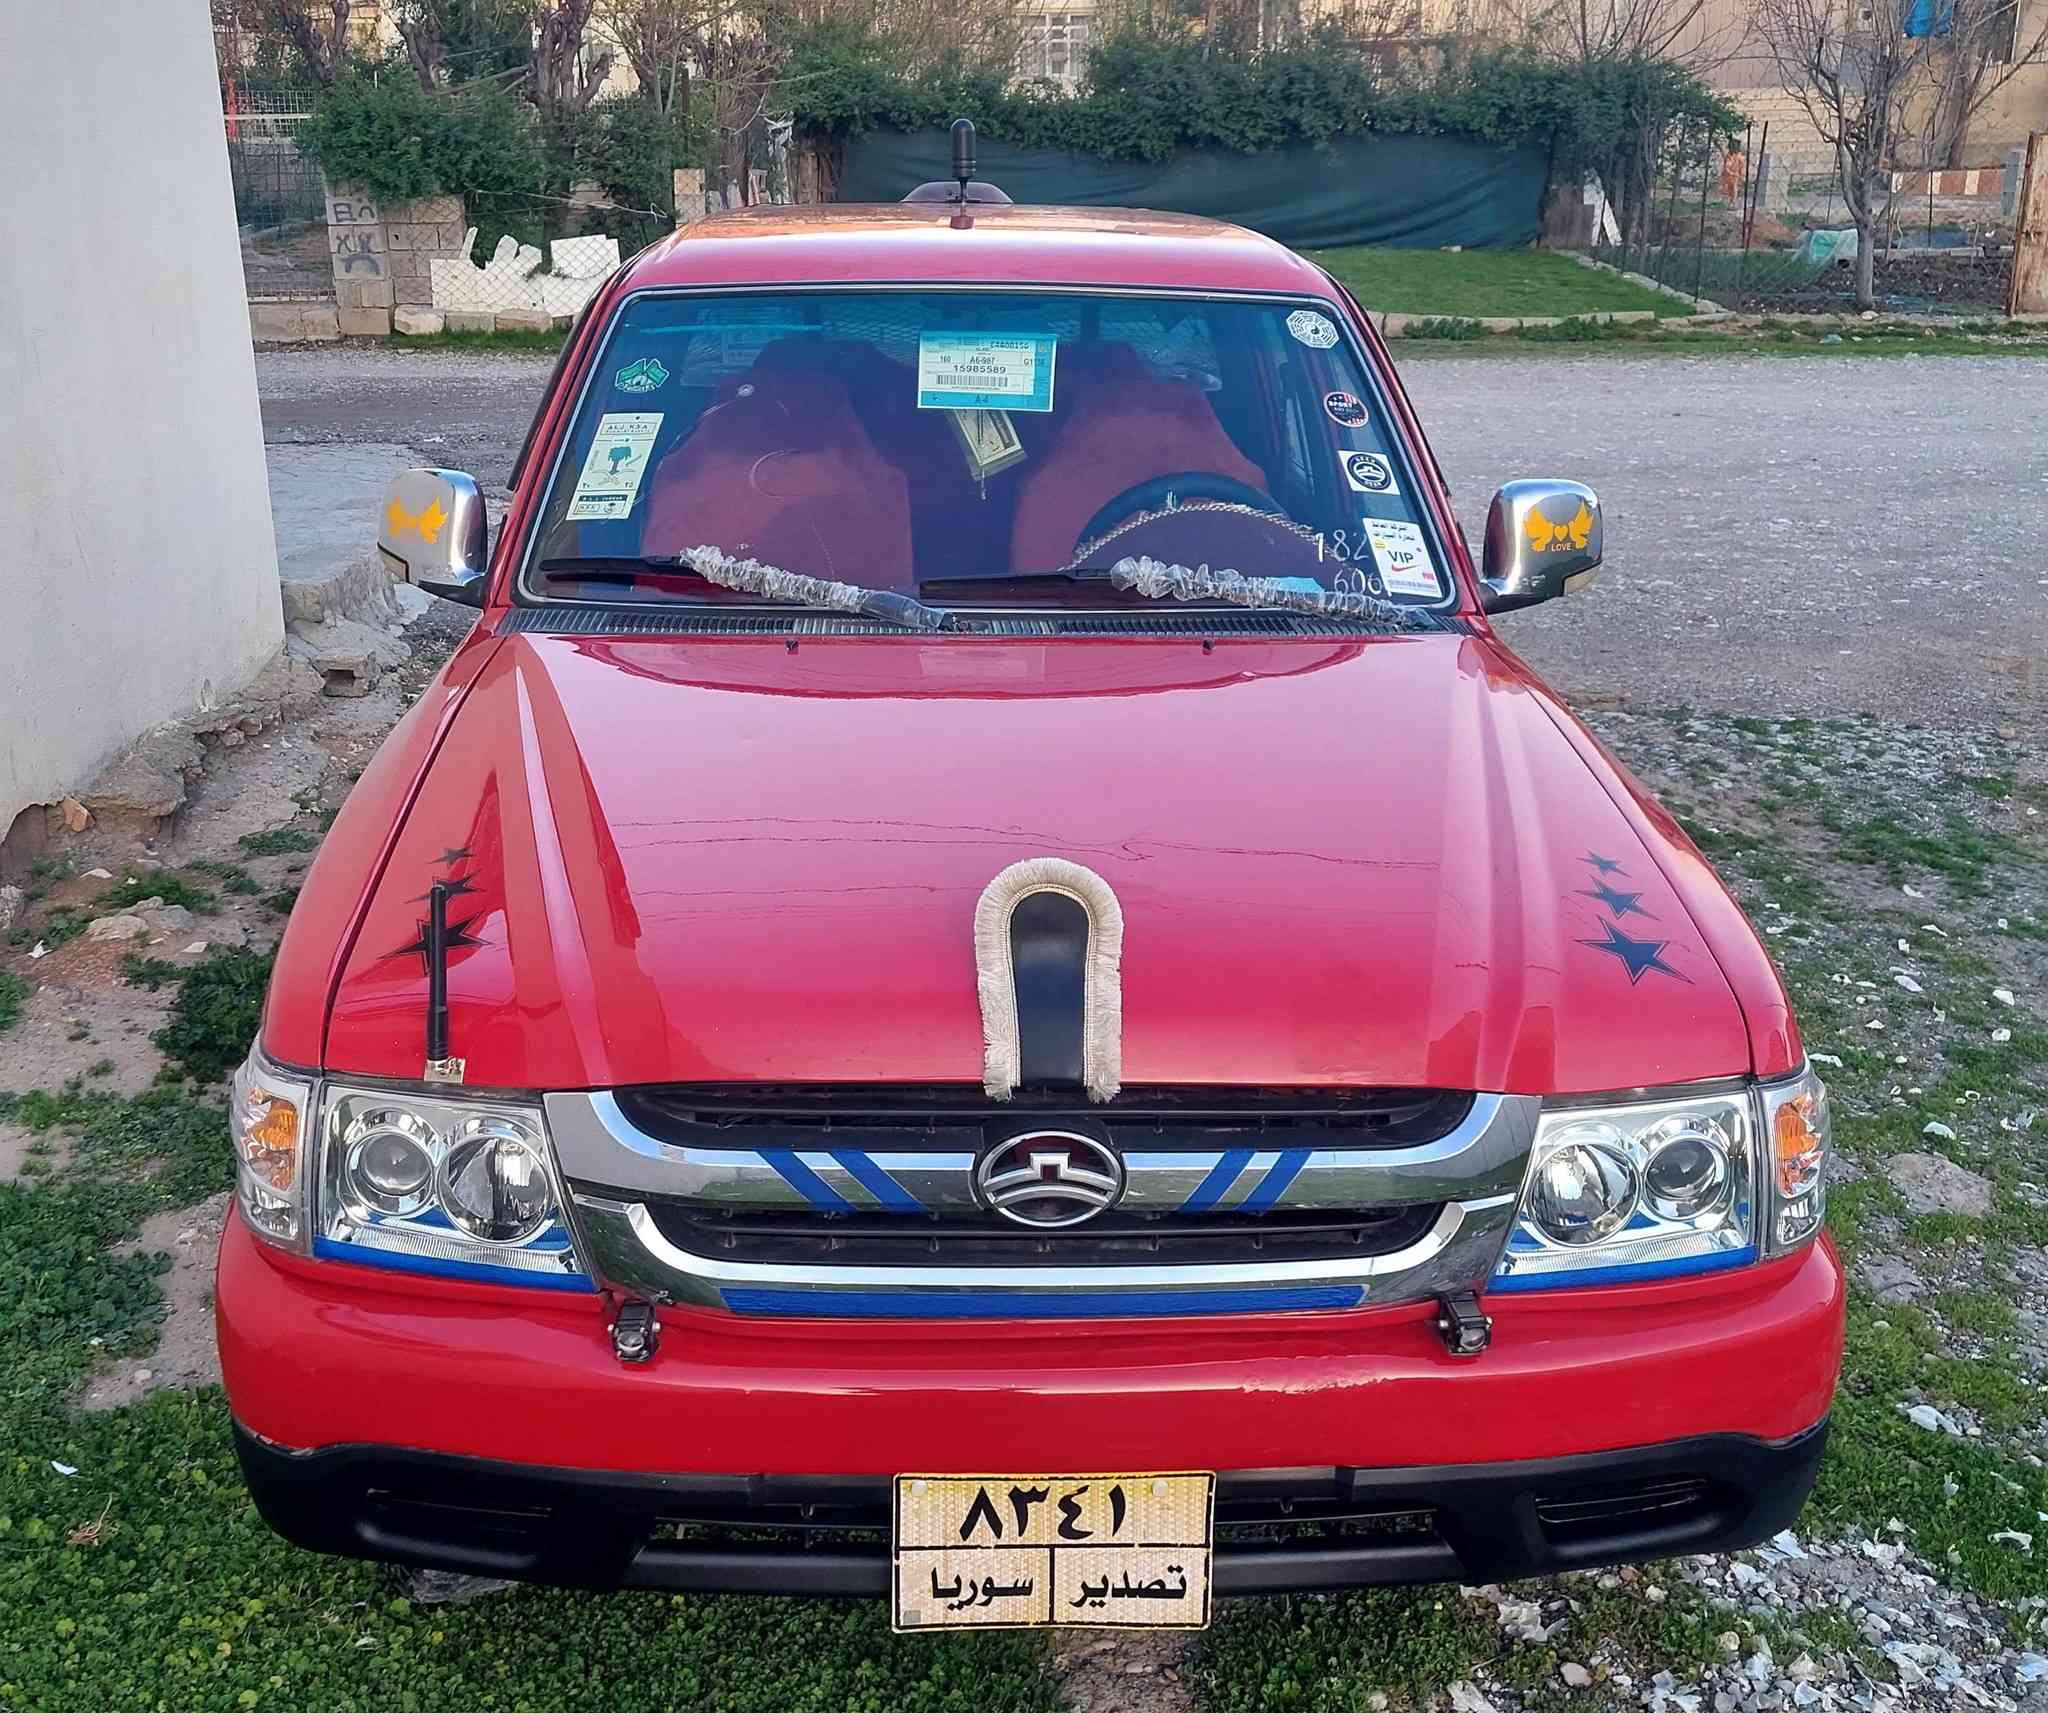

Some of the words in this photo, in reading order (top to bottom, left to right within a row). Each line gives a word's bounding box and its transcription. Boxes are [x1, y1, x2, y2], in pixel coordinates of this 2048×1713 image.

[953, 364, 1007, 374] 15985589
[1387, 550, 1415, 564] VIP
[1551, 542, 1573, 552] LOVE
[959, 1484, 1127, 1542] ٨٣٤١
[930, 1566, 1034, 1611] سوريا
[1068, 1564, 1188, 1609] تصدير
